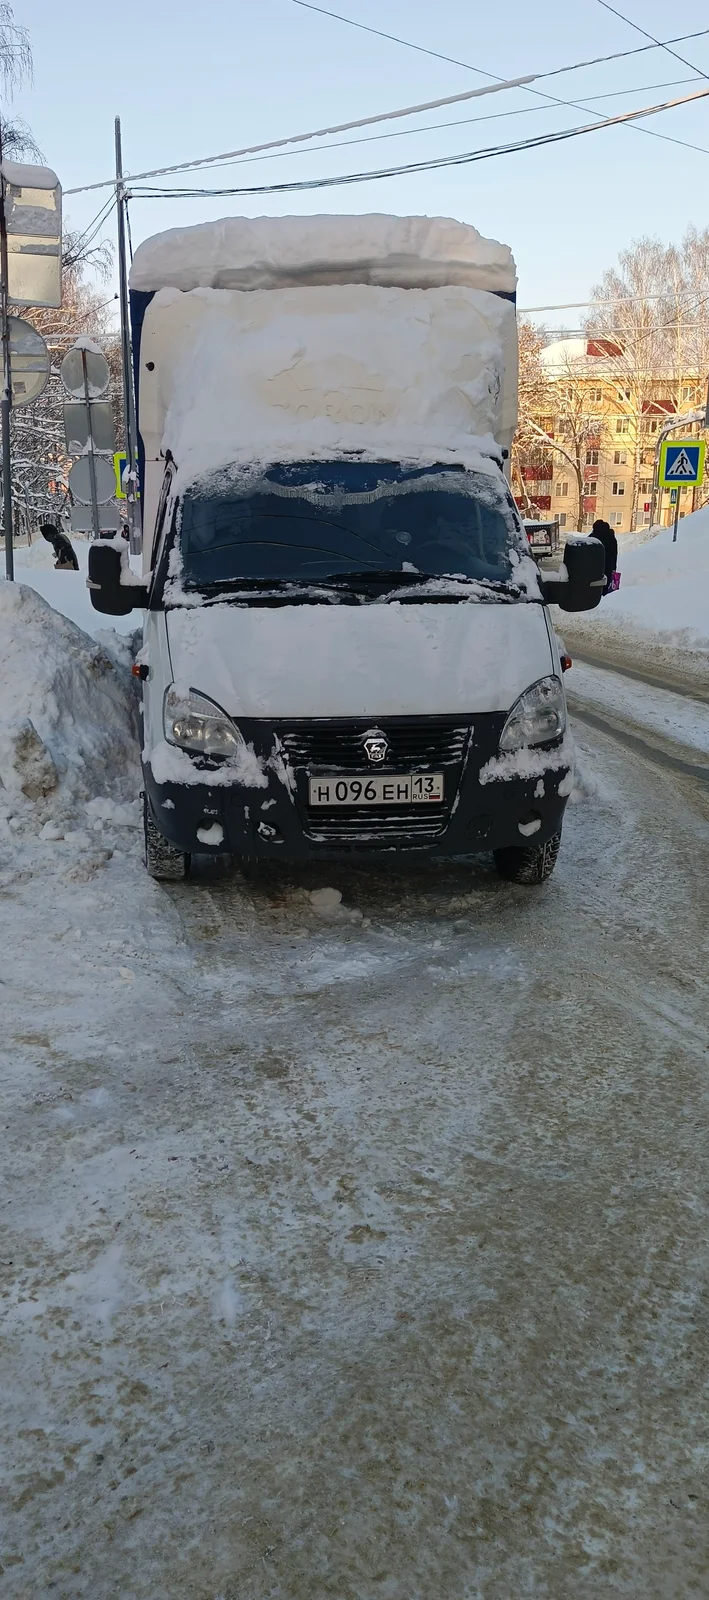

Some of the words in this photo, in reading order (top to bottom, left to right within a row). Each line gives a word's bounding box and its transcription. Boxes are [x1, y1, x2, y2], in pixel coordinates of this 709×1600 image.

[318, 786, 329, 802] Н
[335, 781, 377, 801] 096
[383, 784, 409, 801] ЕН
[414, 777, 434, 793] 13
